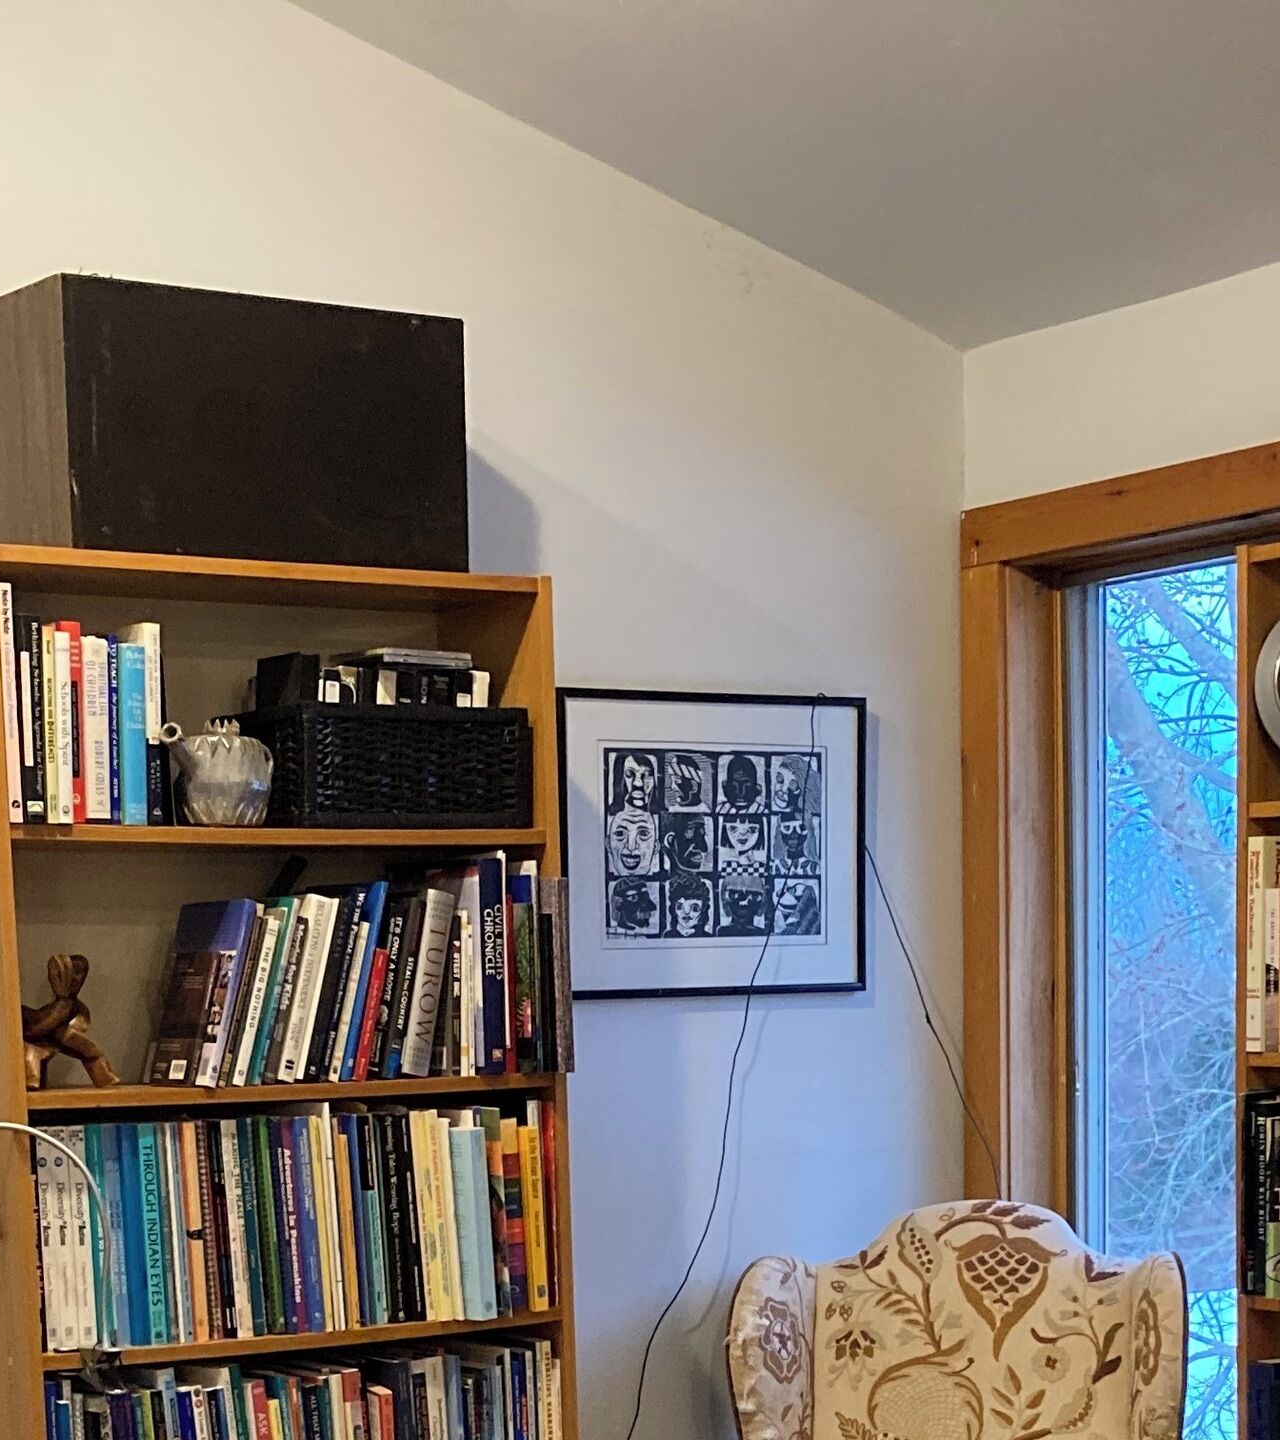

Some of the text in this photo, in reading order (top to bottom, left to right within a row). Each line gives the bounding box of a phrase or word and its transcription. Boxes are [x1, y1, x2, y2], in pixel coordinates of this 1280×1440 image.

[0, 589, 9, 608] Note
[2, 617, 10, 635] Note
[109, 643, 117, 658] TO
[109, 658, 117, 688] TEACH
[58, 681, 70, 716] Schools
[59, 719, 70, 739] with
[483, 908, 496, 976] CHRONICLE
[494, 904, 504, 980] CIVIL RIGHTS
[246, 946, 271, 1030] THE BIG NOTHING
[416, 928, 447, 1046] TUROW
[1256, 1116, 1265, 1151] ROBIN
[281, 1147, 296, 1212] Adventures
[1257, 1153, 1265, 1182] HOOD
[39, 1182, 50, 1219] Diversity
[55, 1181, 66, 1219] Diversity
[74, 1181, 85, 1220] Diversity
[140, 1143, 163, 1307] THROUGH INDIAN EYES
[288, 1214, 296, 1226] in
[255, 1411, 268, 1435] ASK
